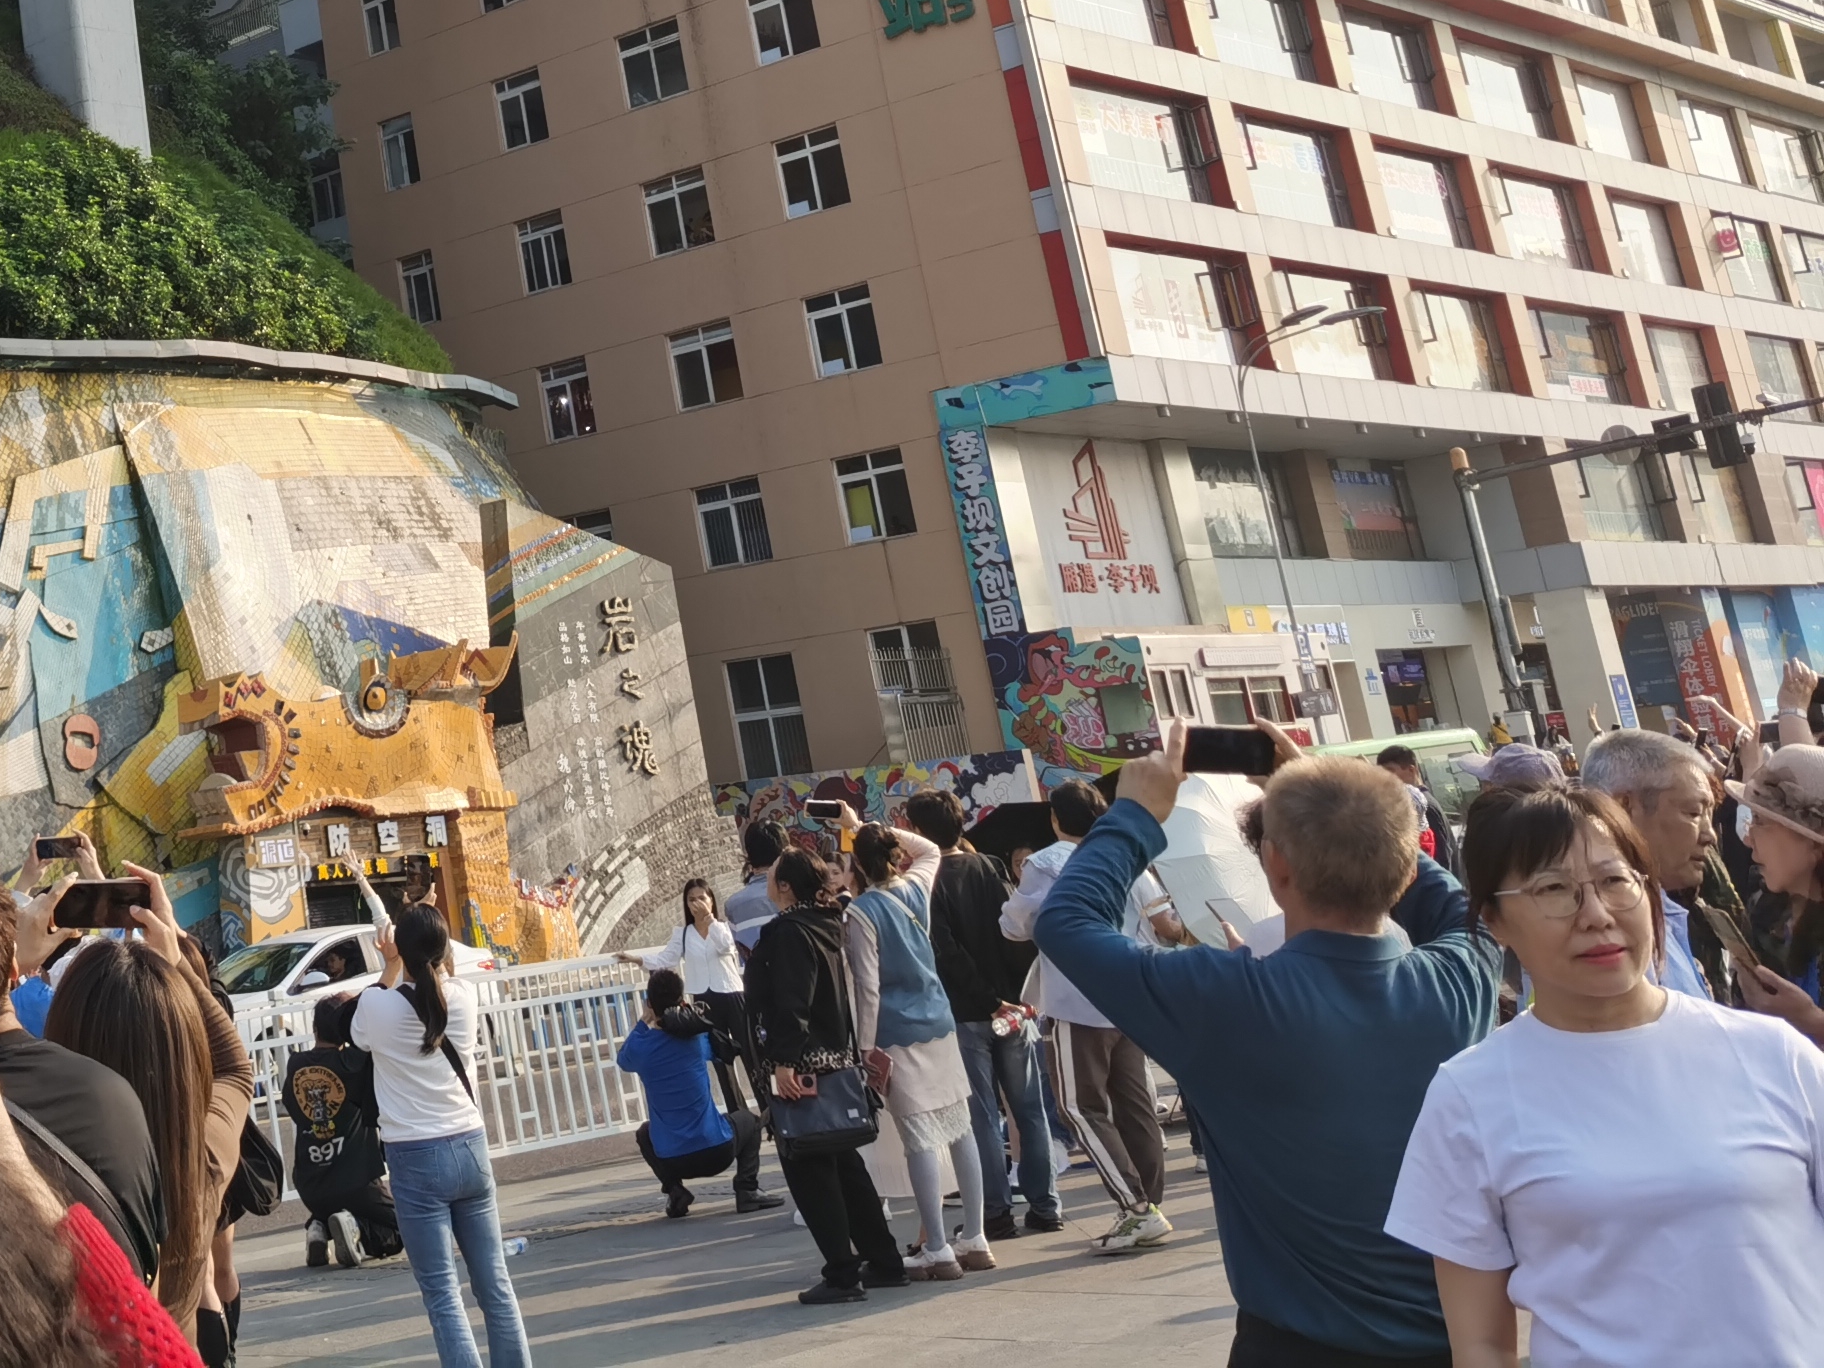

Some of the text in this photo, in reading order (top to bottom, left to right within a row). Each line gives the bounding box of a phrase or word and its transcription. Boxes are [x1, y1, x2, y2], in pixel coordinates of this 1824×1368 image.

[947, 428, 1021, 636] 李子坝文创园
[558, 621, 574, 665] 品格如山
[586, 677, 601, 724] 人生有限
[601, 595, 662, 776] 岩之魂
[327, 814, 449, 858] 防空洞
[308, 1136, 345, 1163] 897
